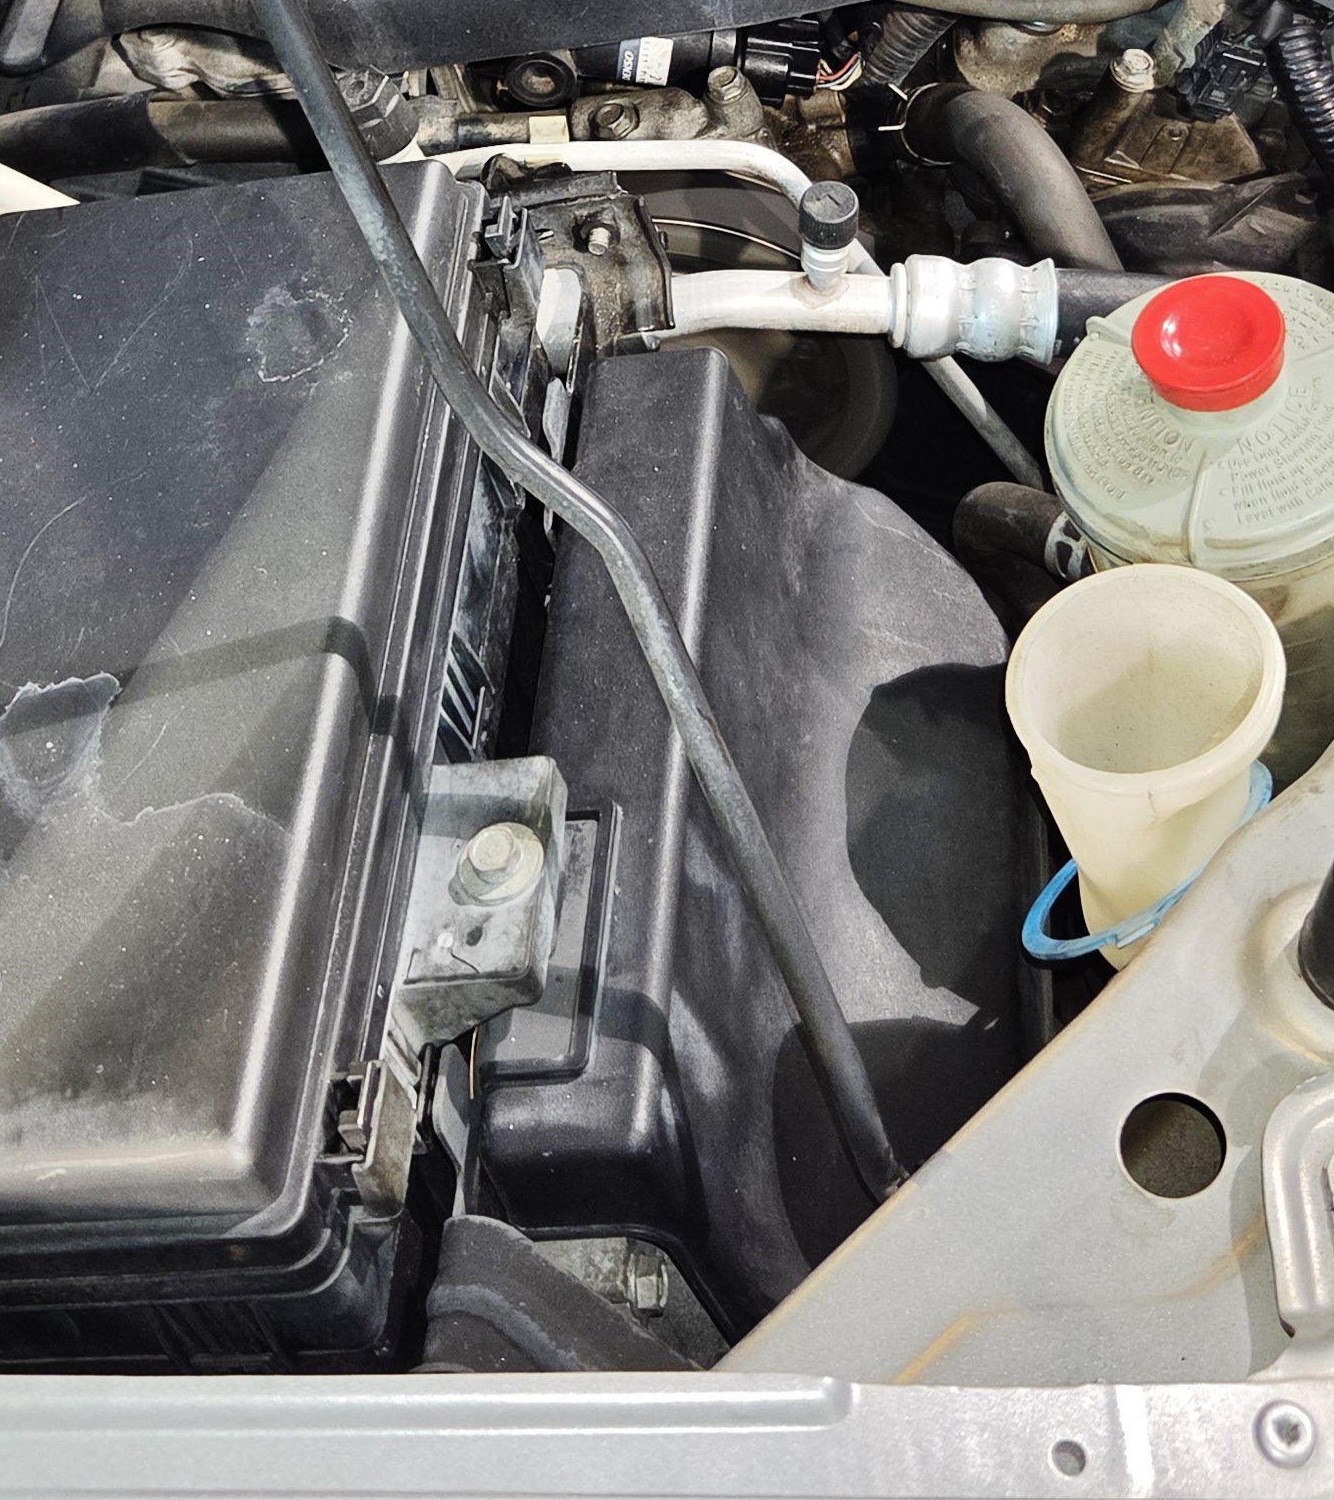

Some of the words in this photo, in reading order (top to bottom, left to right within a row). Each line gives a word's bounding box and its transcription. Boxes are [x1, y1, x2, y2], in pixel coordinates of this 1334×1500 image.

[1236, 386, 1309, 455] NOTICE
[1230, 462, 1271, 483] Power
[1236, 508, 1275, 525] Level
